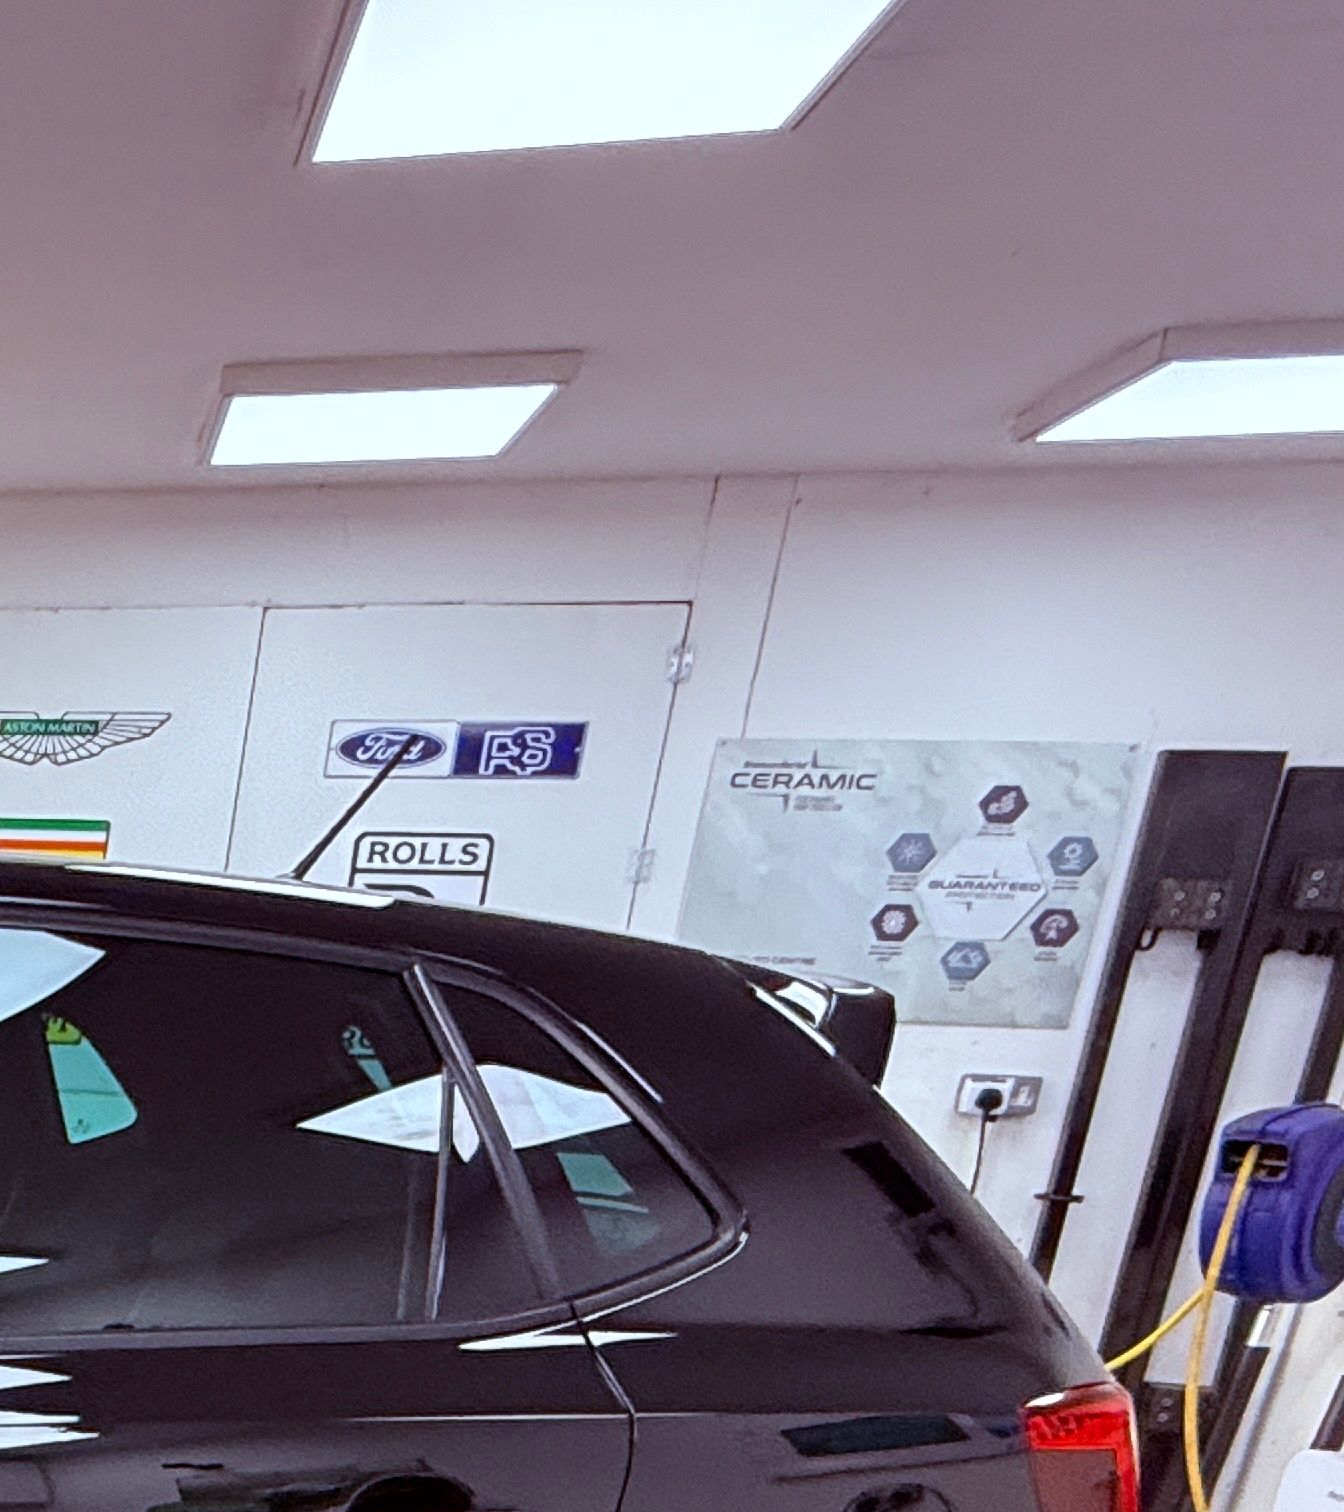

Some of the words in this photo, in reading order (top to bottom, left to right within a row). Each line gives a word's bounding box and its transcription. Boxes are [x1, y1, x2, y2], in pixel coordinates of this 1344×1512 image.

[2, 721, 45, 733] ASTON
[47, 722, 96, 734] MARTIN
[479, 726, 556, 776] RS
[730, 772, 878, 791] CERAMIC
[366, 841, 481, 866] ROLLS
[928, 880, 1041, 892] GUARANTEED
